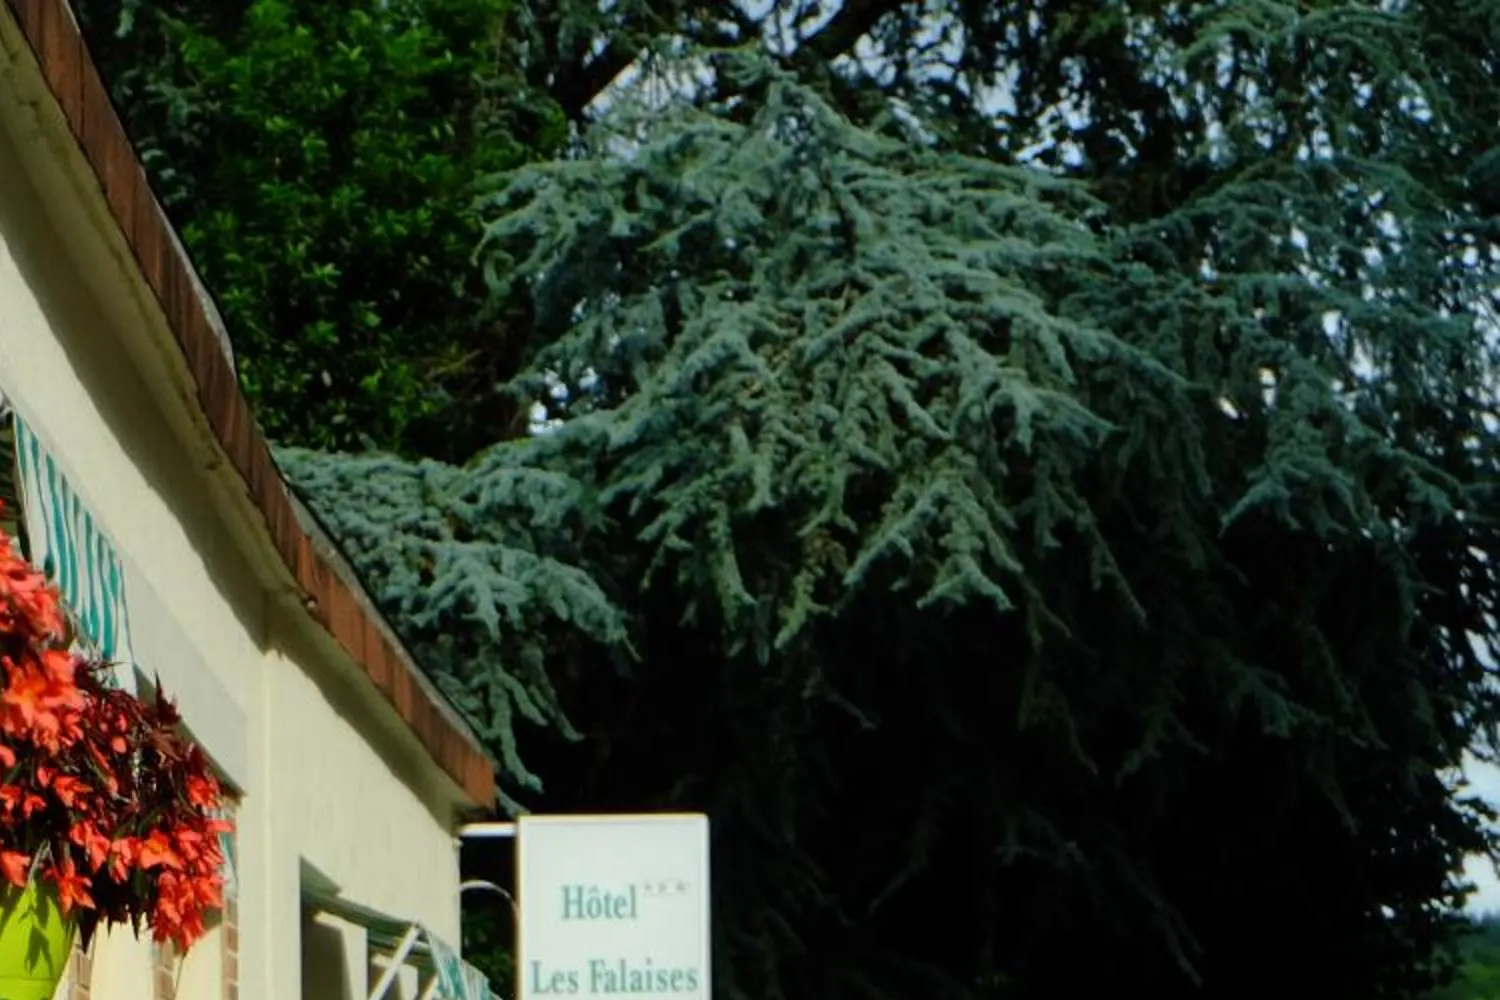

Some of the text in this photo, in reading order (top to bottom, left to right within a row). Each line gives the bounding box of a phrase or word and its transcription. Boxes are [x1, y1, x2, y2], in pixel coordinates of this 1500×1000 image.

[562, 884, 637, 920] Hôtel
[531, 958, 698, 994] Les Falaises
